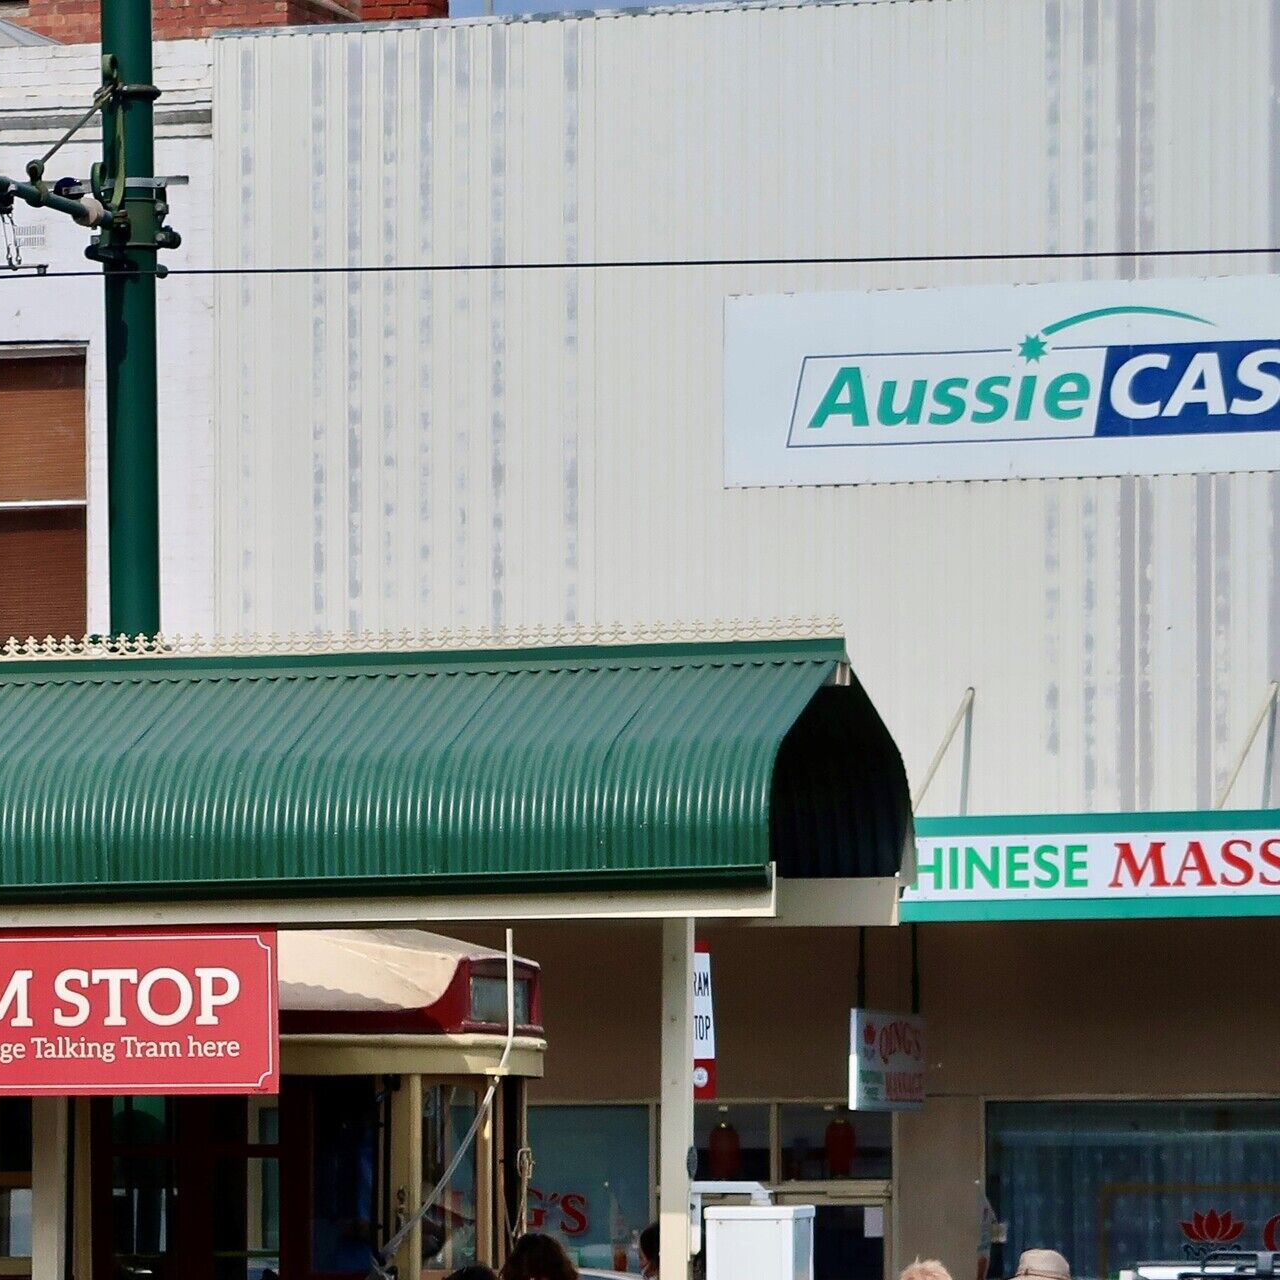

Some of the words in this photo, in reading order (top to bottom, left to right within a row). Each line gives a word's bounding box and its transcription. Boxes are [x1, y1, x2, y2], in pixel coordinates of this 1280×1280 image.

[54, 967, 241, 1027] STOP
[31, 1036, 116, 1062] Talking
[121, 1036, 183, 1058] Tram
[187, 1035, 241, 1058] here
